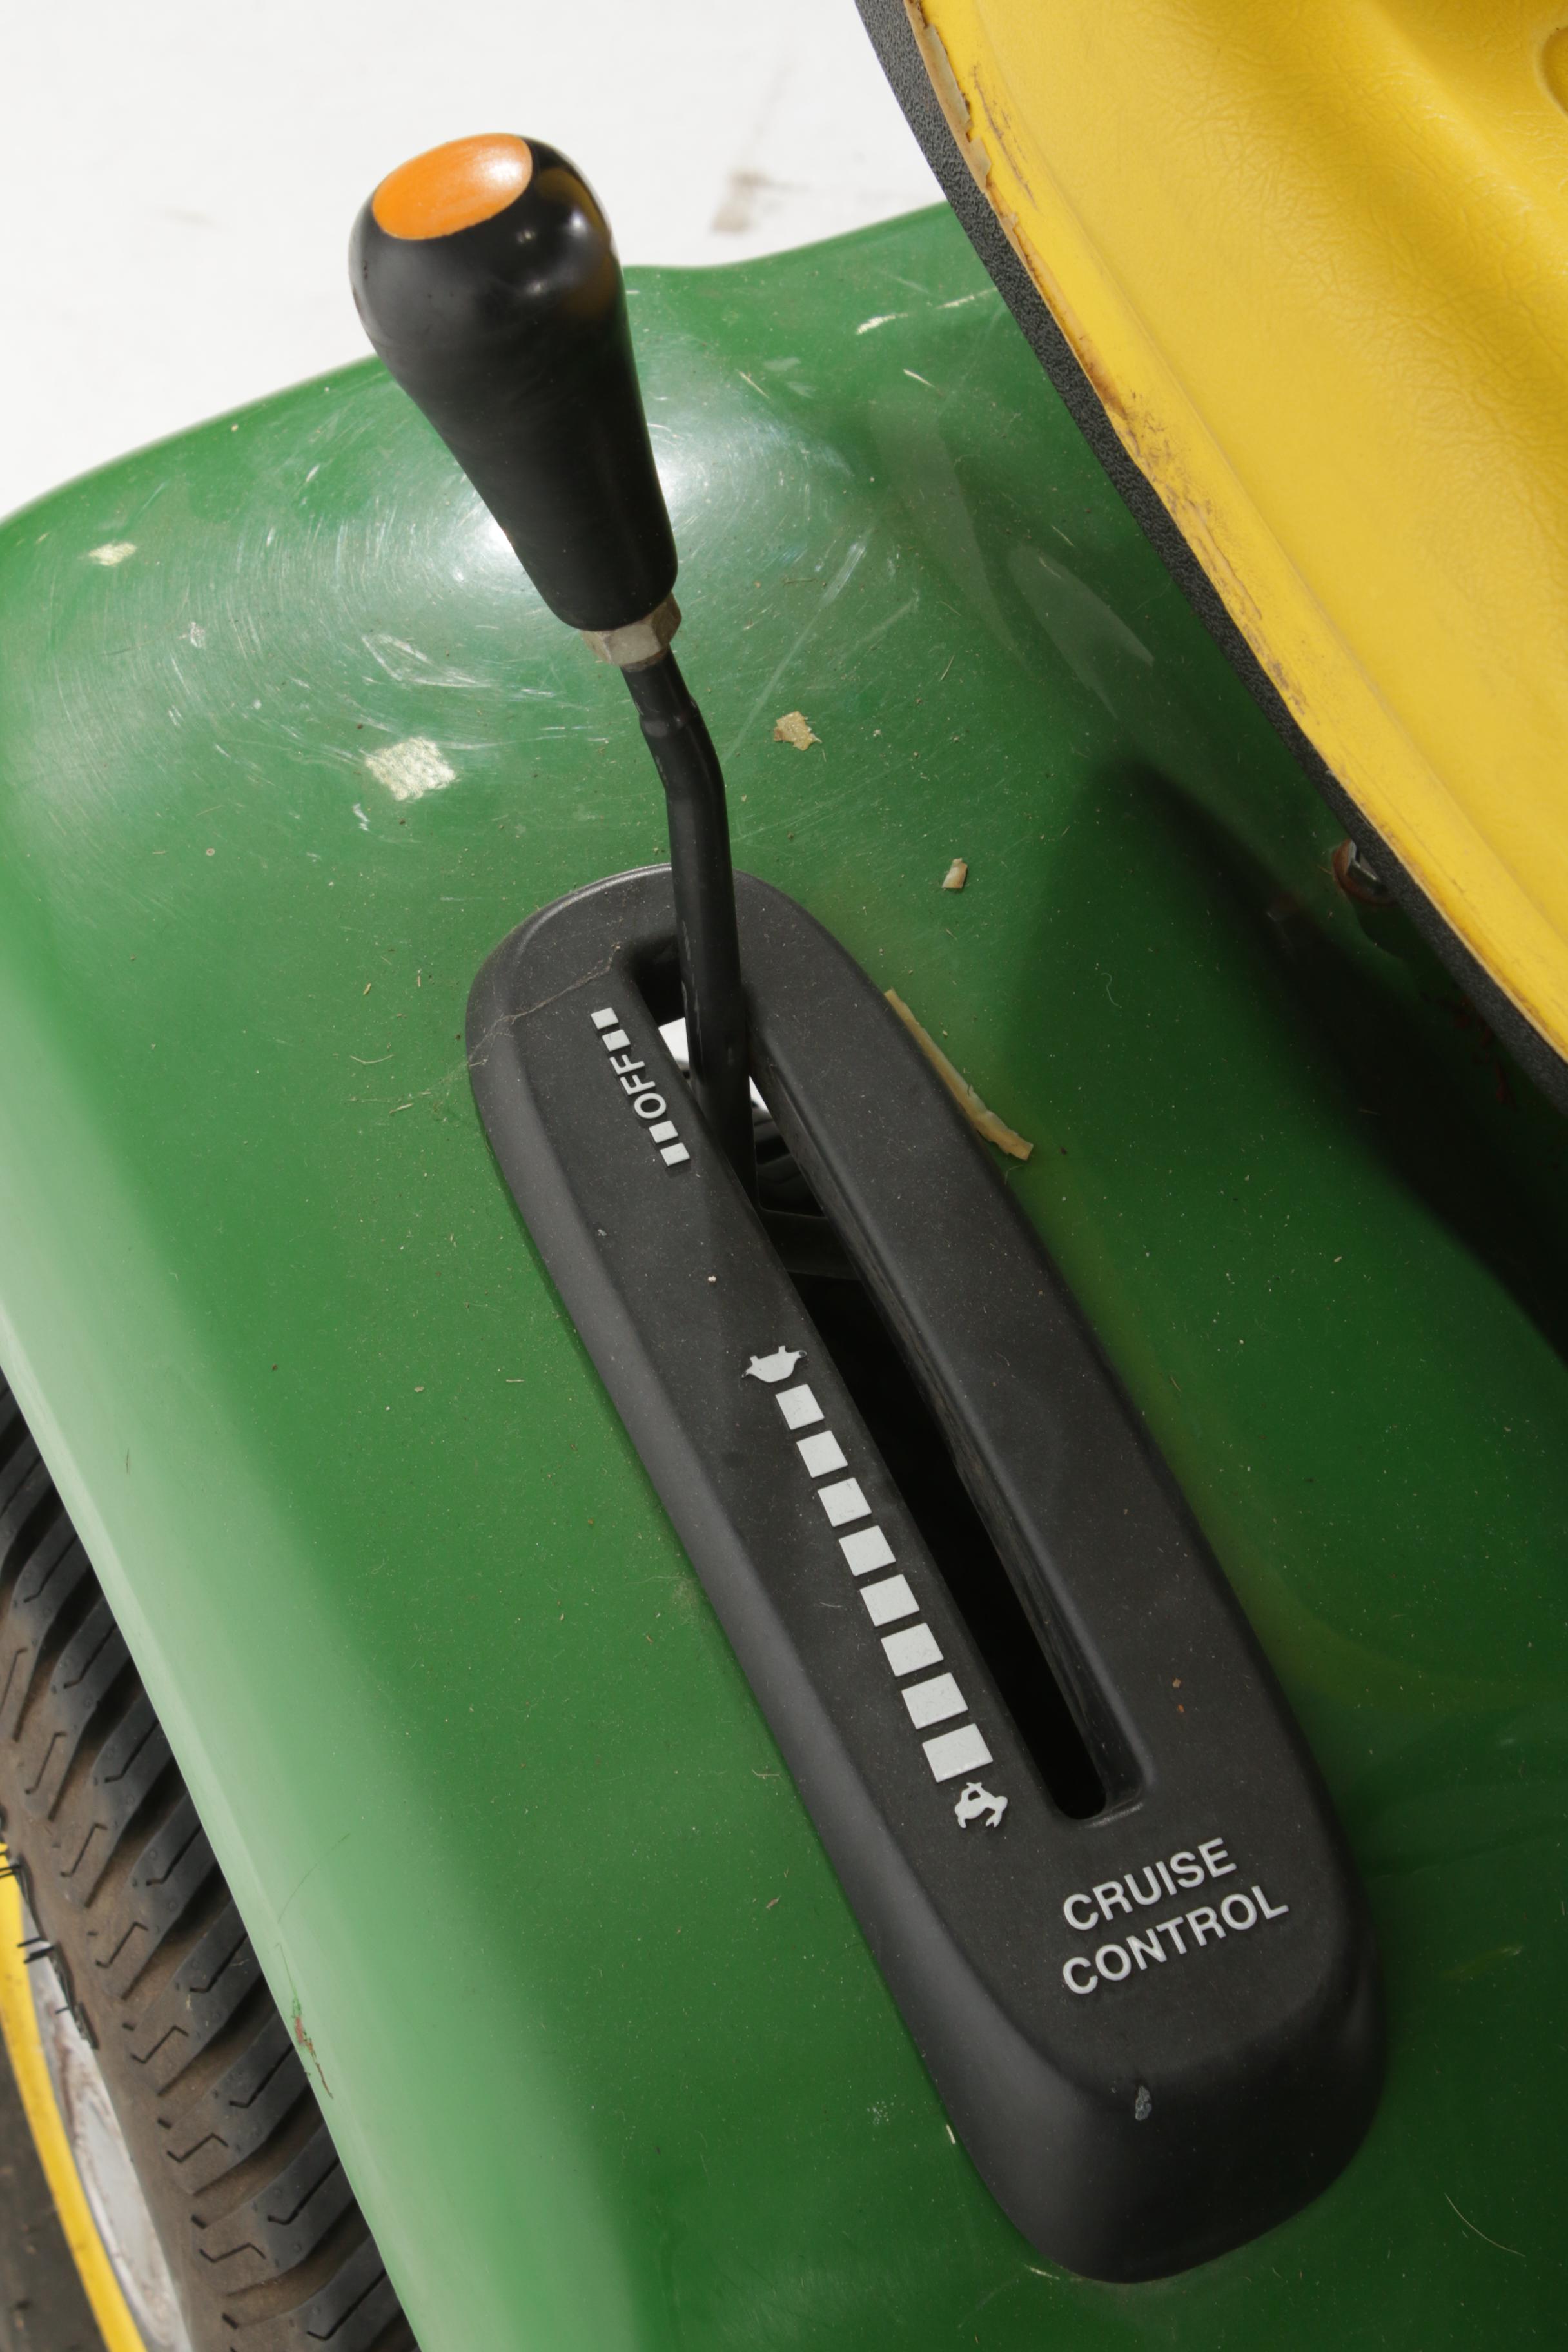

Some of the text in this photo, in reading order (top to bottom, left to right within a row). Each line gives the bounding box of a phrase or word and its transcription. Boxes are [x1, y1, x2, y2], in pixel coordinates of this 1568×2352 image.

[609, 1054, 667, 1119] OFF
[1063, 1838, 1237, 1930] CRUISE
[1063, 1885, 1289, 1994] CONTROL
